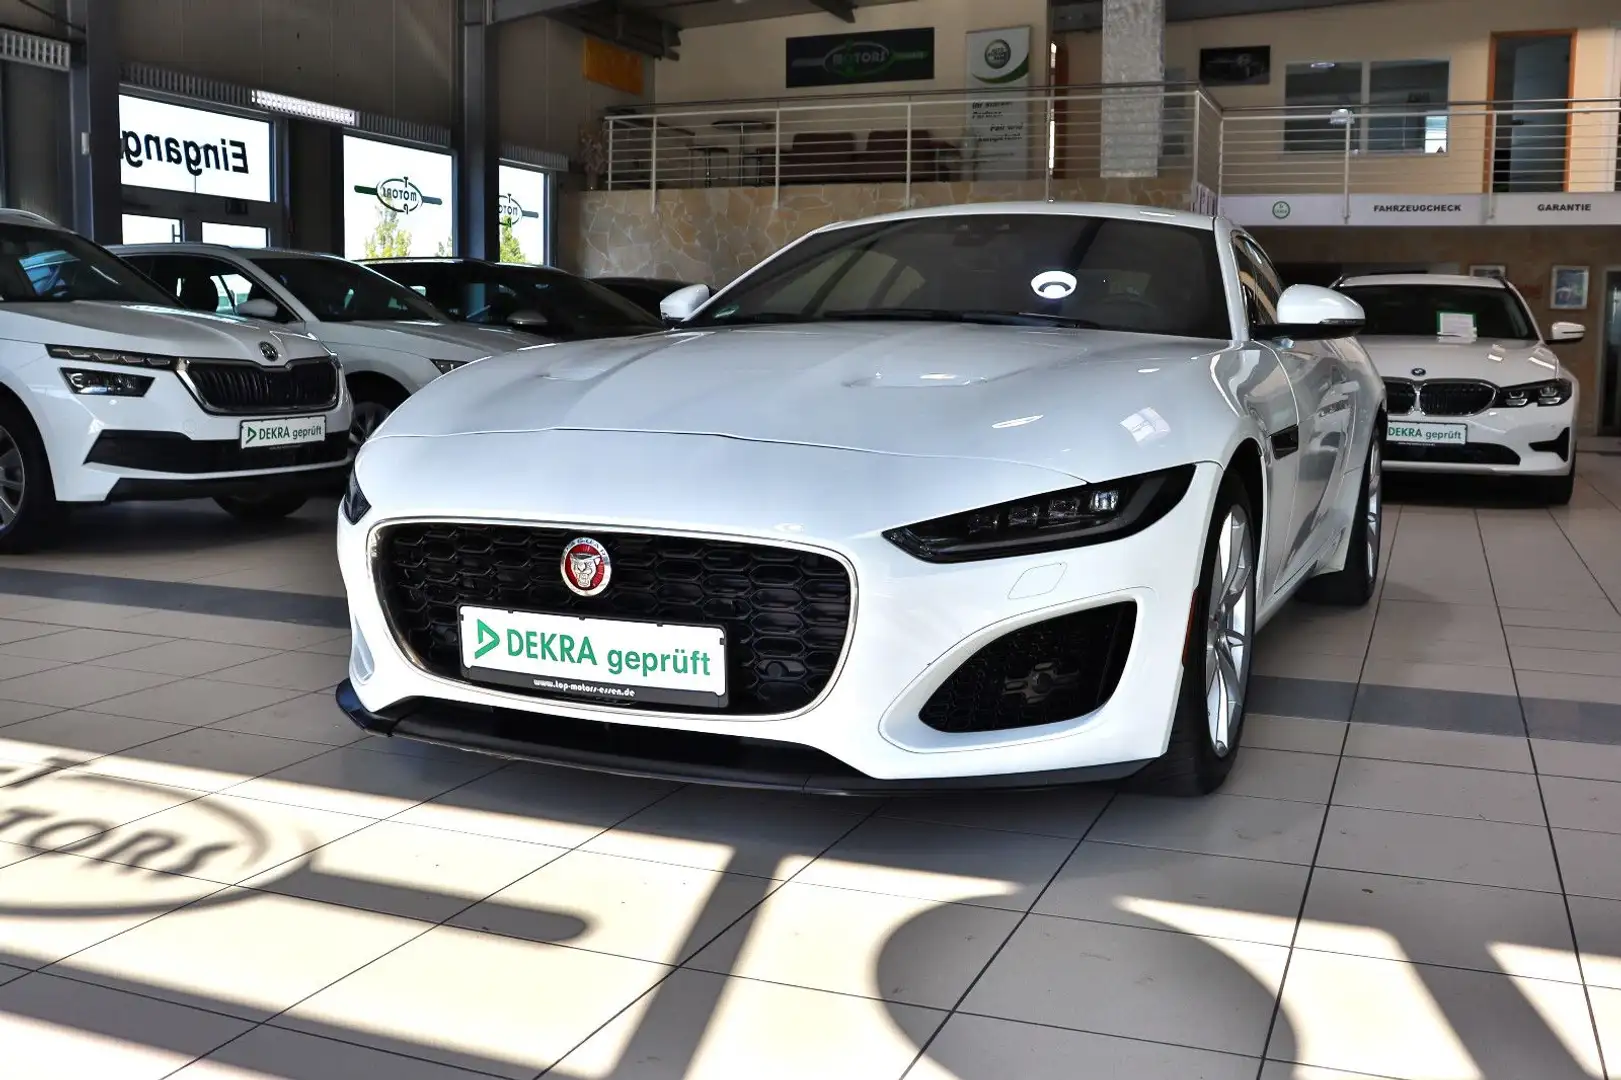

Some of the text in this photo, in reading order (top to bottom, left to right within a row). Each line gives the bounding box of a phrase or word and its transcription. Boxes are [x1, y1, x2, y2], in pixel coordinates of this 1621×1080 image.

[832, 50, 886, 66] MOTORS
[1373, 204, 1462, 212] FAHRZEUGCHECK
[1537, 203, 1592, 212] GARANTIE
[259, 425, 322, 440] DEKRA geprüft
[1388, 427, 1462, 440] DEKRA geprüft
[506, 628, 711, 677] DEKRA geprüft
[533, 678, 636, 697] www.top-motors-essen.de
